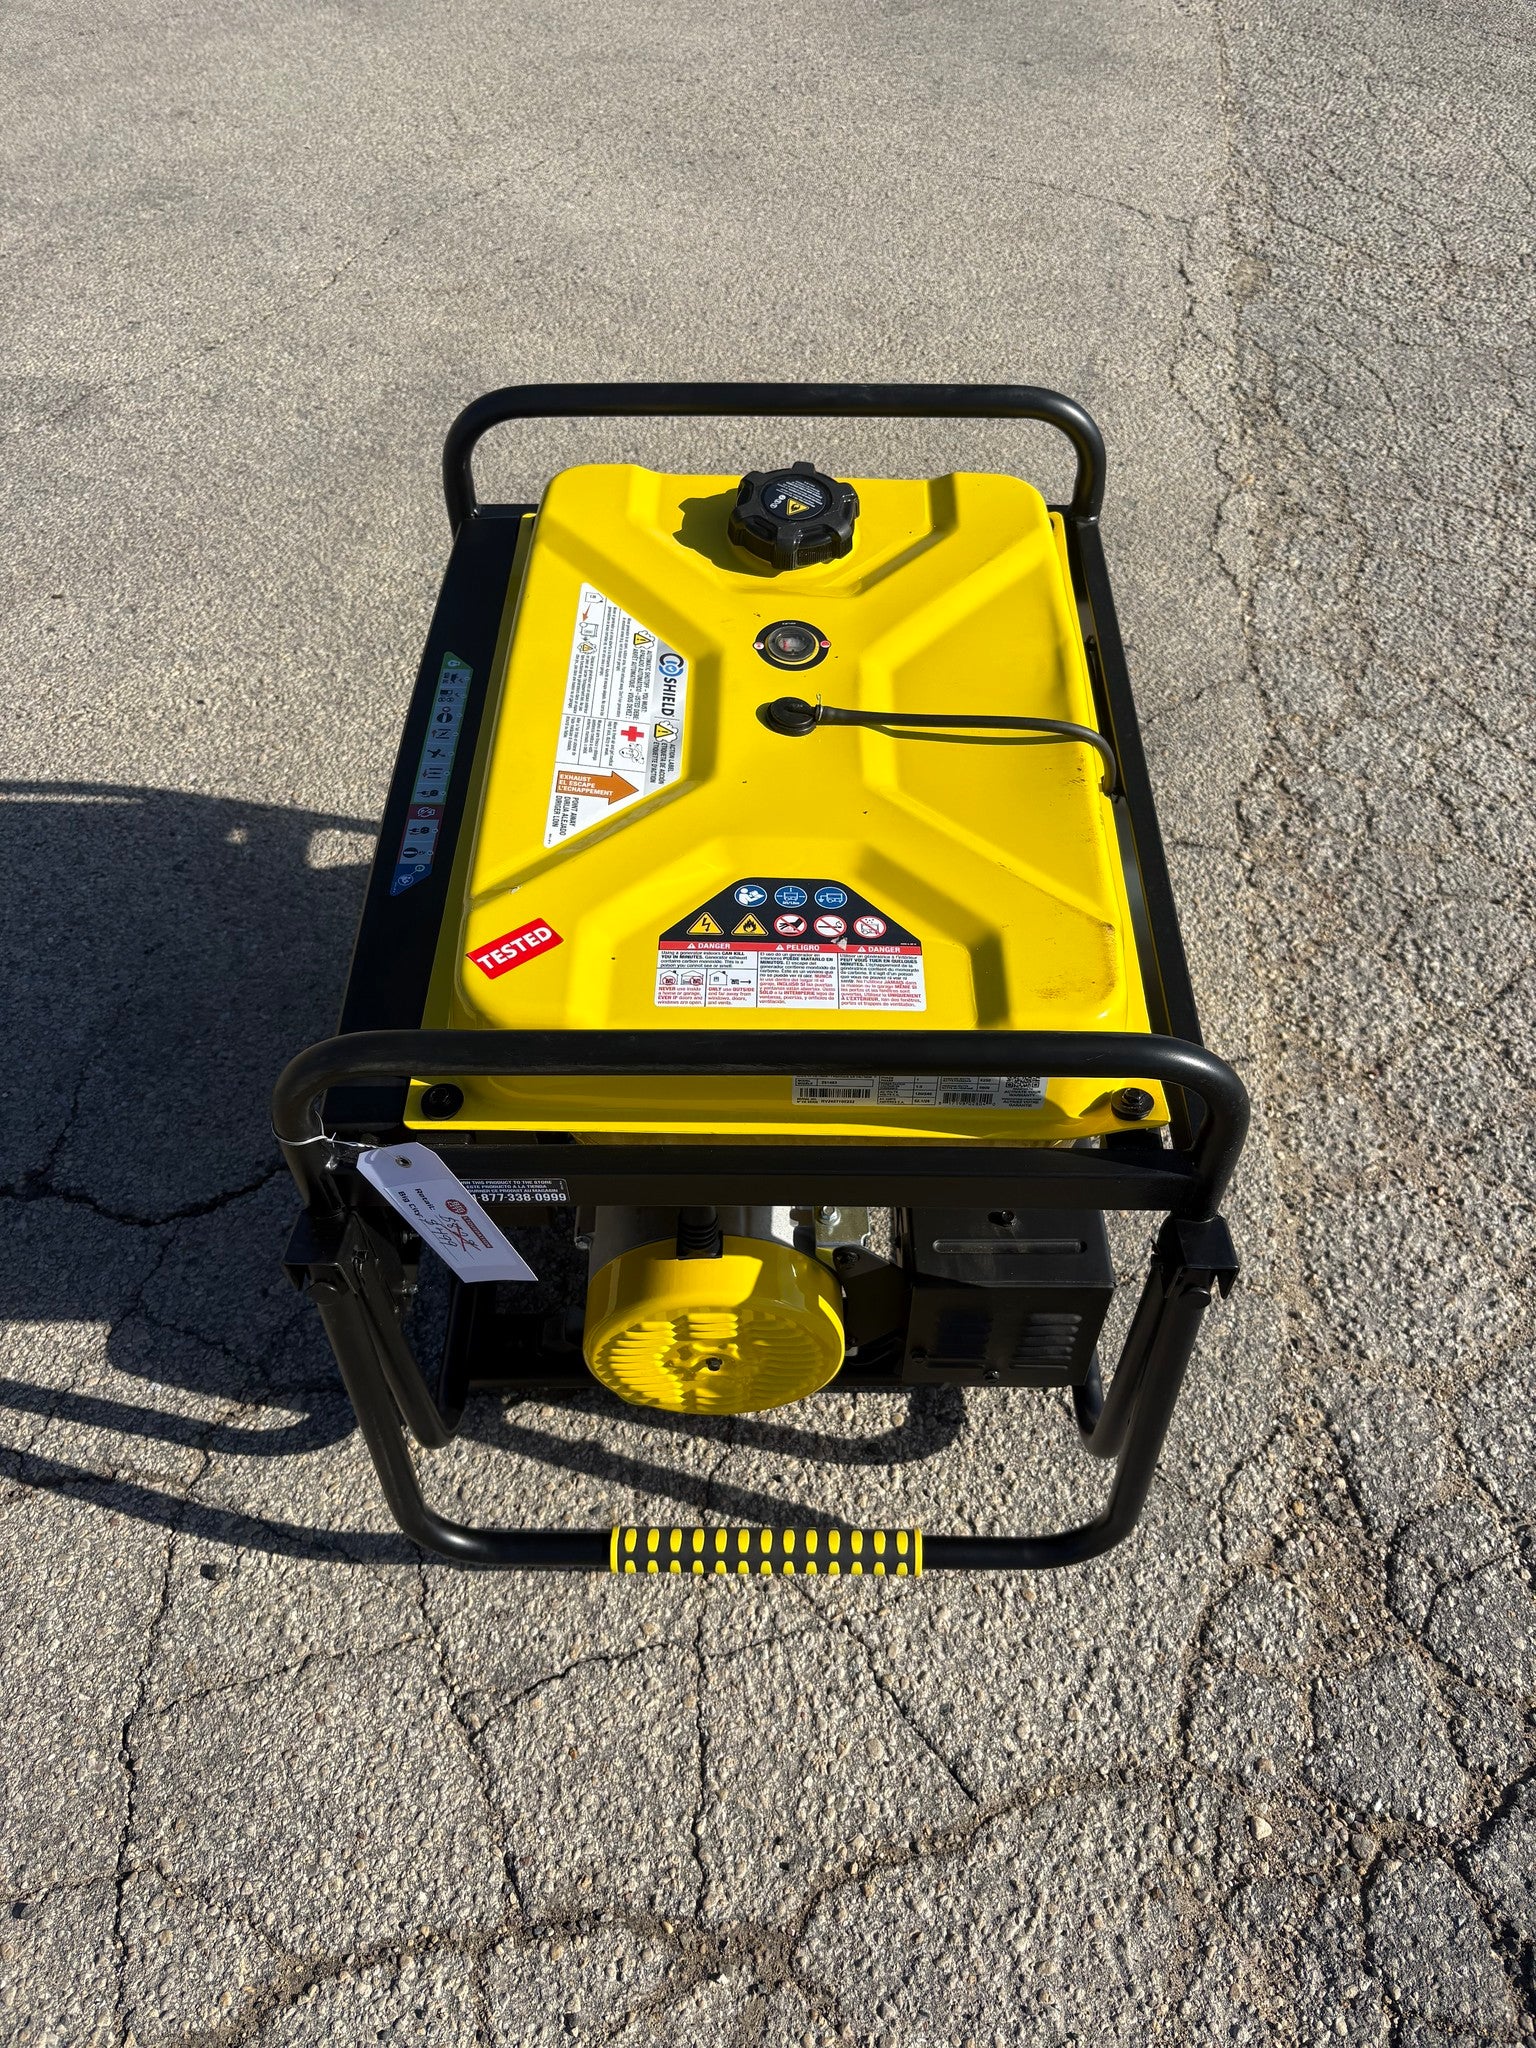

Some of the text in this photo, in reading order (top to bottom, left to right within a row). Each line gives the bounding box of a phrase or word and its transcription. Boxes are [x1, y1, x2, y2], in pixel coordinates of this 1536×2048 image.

[644, 650, 653, 671] AUTOMATIC
[628, 661, 637, 688] AUTOMATIQUE
[640, 700, 648, 712] MUST:
[662, 677, 677, 718] SHIELD
[659, 742, 667, 761] ETIQUETA
[668, 743, 676, 758] ACTION
[559, 773, 591, 782] EXHAUST
[568, 780, 595, 788] ESCAPE
[551, 795, 562, 827] DIRIGER LOIN
[559, 796, 570, 835] DIRIJA ALEJADO
[568, 796, 579, 826] POINT AWAY
[476, 927, 552, 970] TESTED
[398, 1191, 409, 1204] Big
[409, 1204, 424, 1221] City:
[414, 1188, 436, 1211] Retail:
[471, 1192, 566, 1202] 1-877-338-0999
